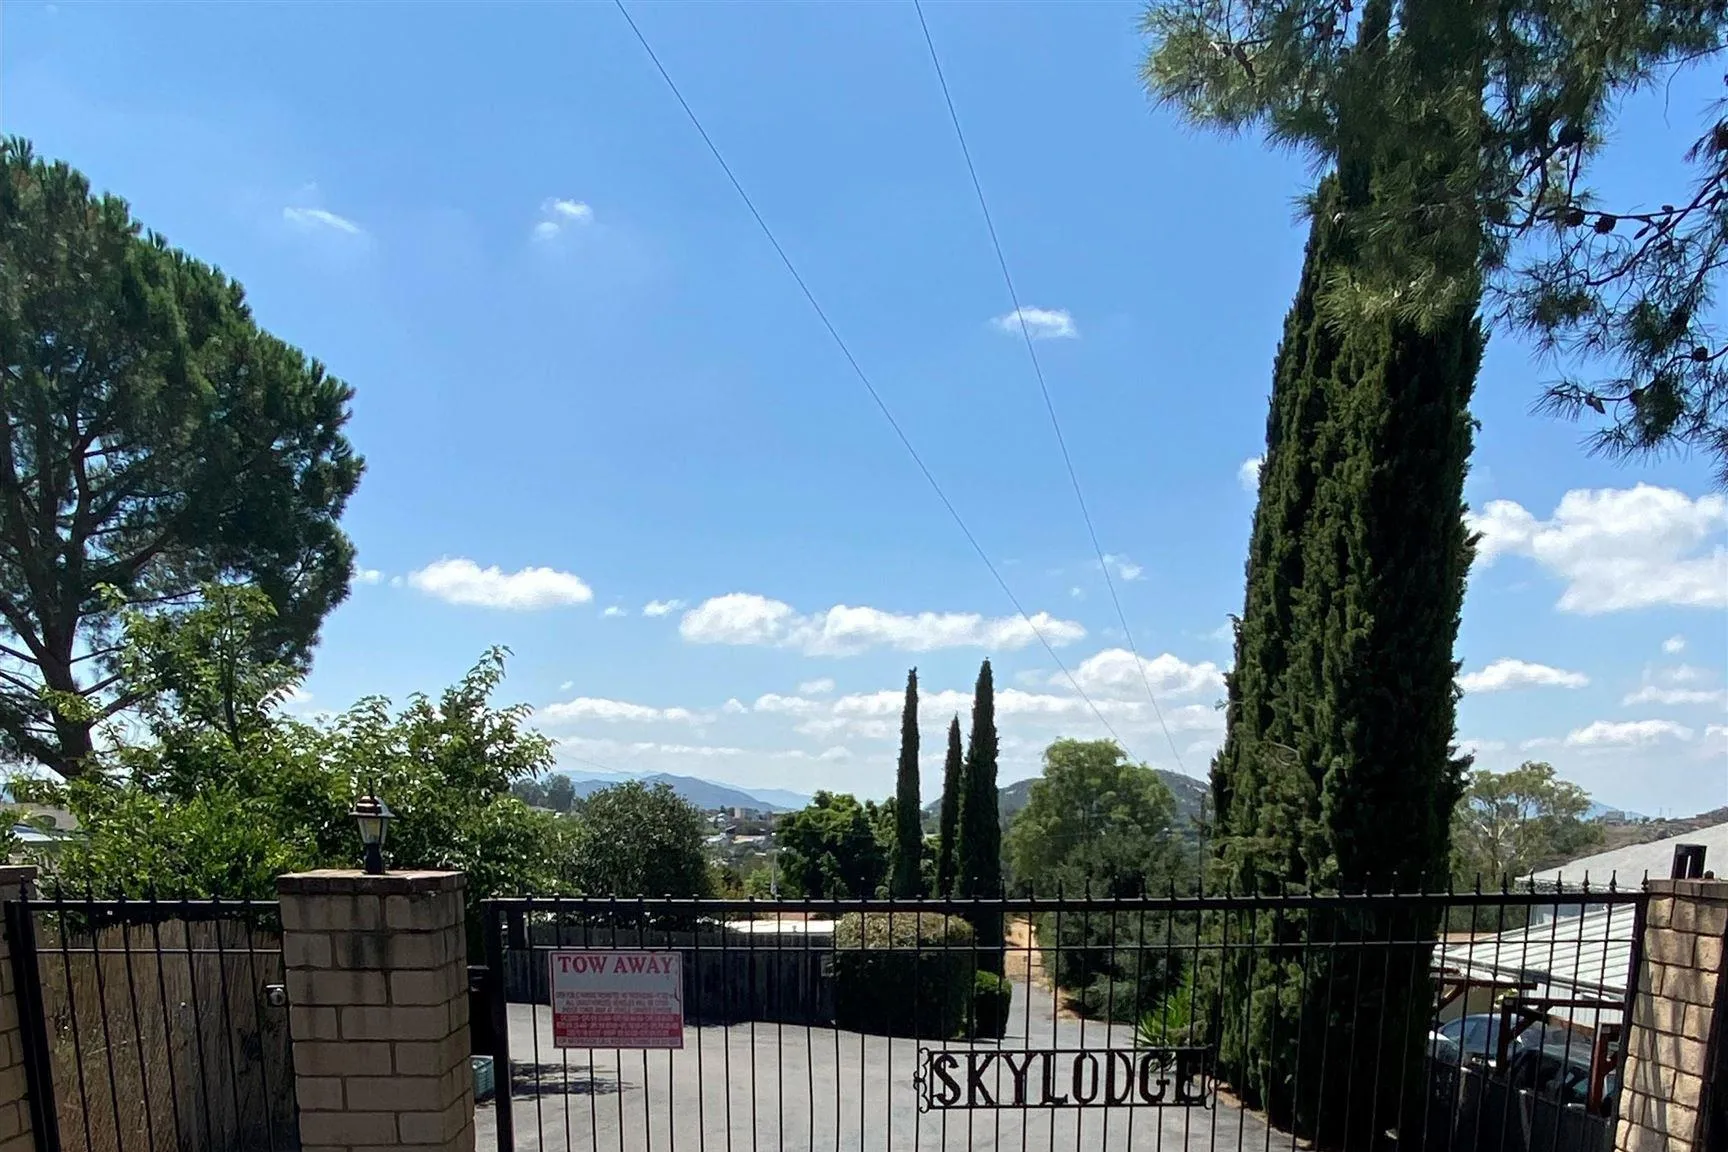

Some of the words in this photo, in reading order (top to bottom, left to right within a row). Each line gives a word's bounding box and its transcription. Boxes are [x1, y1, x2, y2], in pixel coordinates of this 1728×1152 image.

[558, 956, 608, 974] TOW
[613, 956, 673, 974] AWAY
[933, 1051, 1205, 1106] SKYLODGE
